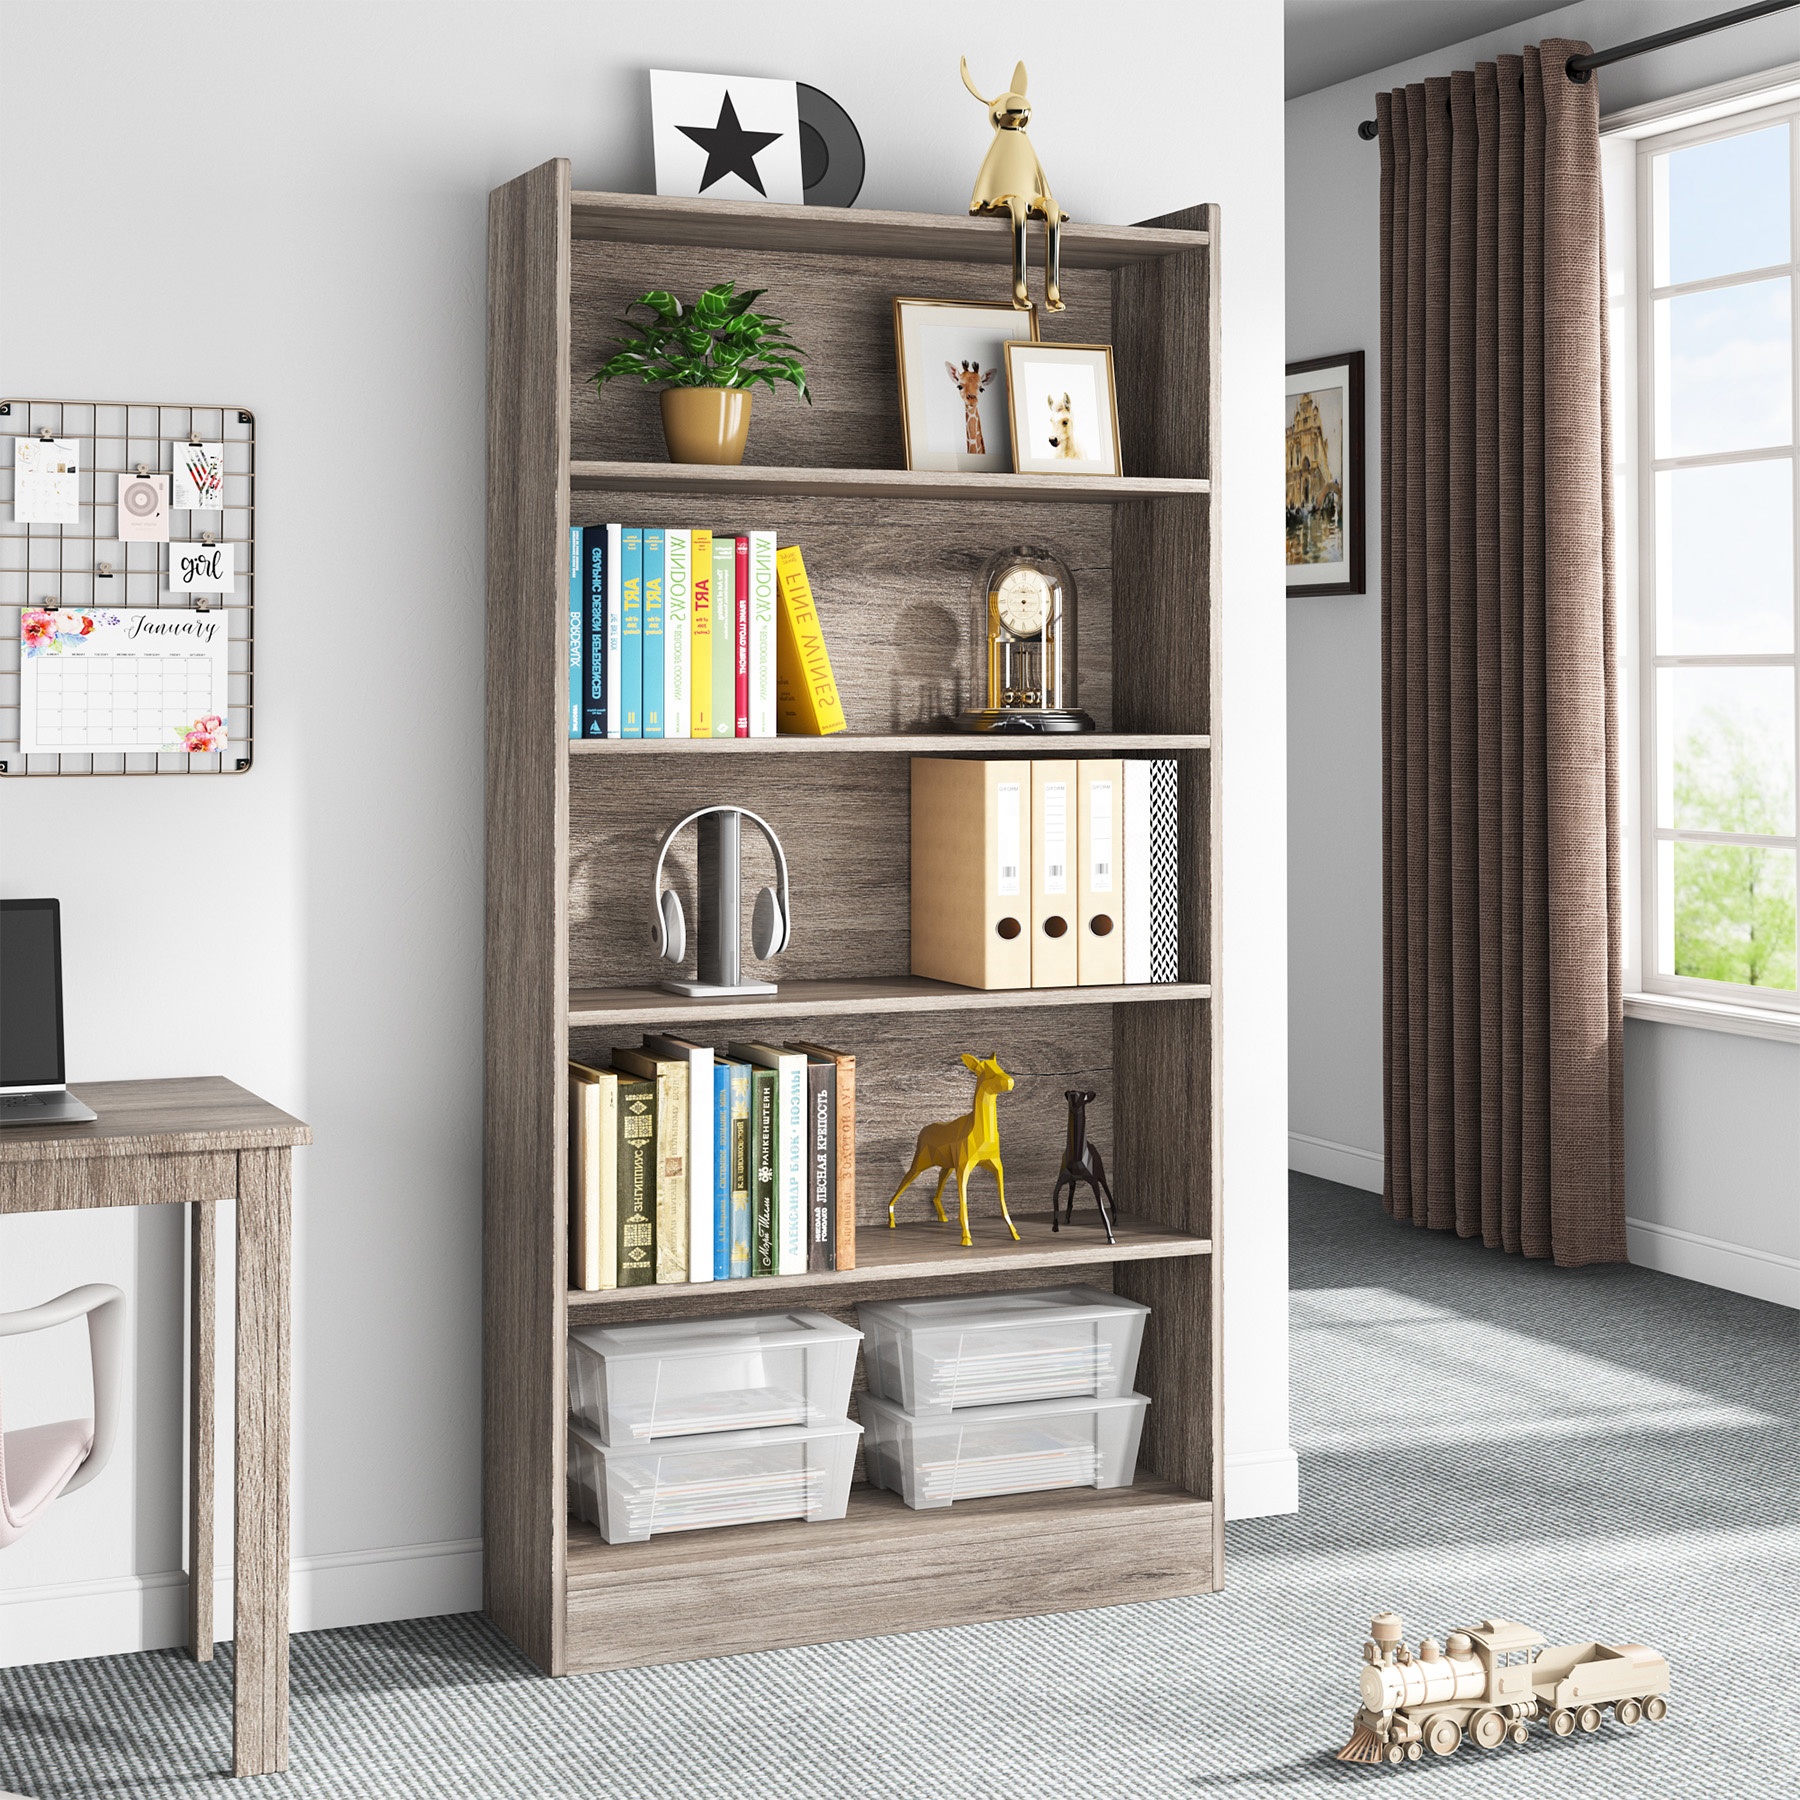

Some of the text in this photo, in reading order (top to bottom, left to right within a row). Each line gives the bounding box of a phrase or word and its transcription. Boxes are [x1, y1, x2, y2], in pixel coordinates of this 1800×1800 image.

[181, 550, 223, 583] girl
[124, 615, 220, 643] January
[788, 1070, 800, 1256] АЛЕКСАНДР БЛОК ПОЭМЫ
[817, 1089, 828, 1203] ЛЕСНАЯ КРЕПОСТЬ
[842, 1118, 851, 1179] ЗОЛОТОЙ
